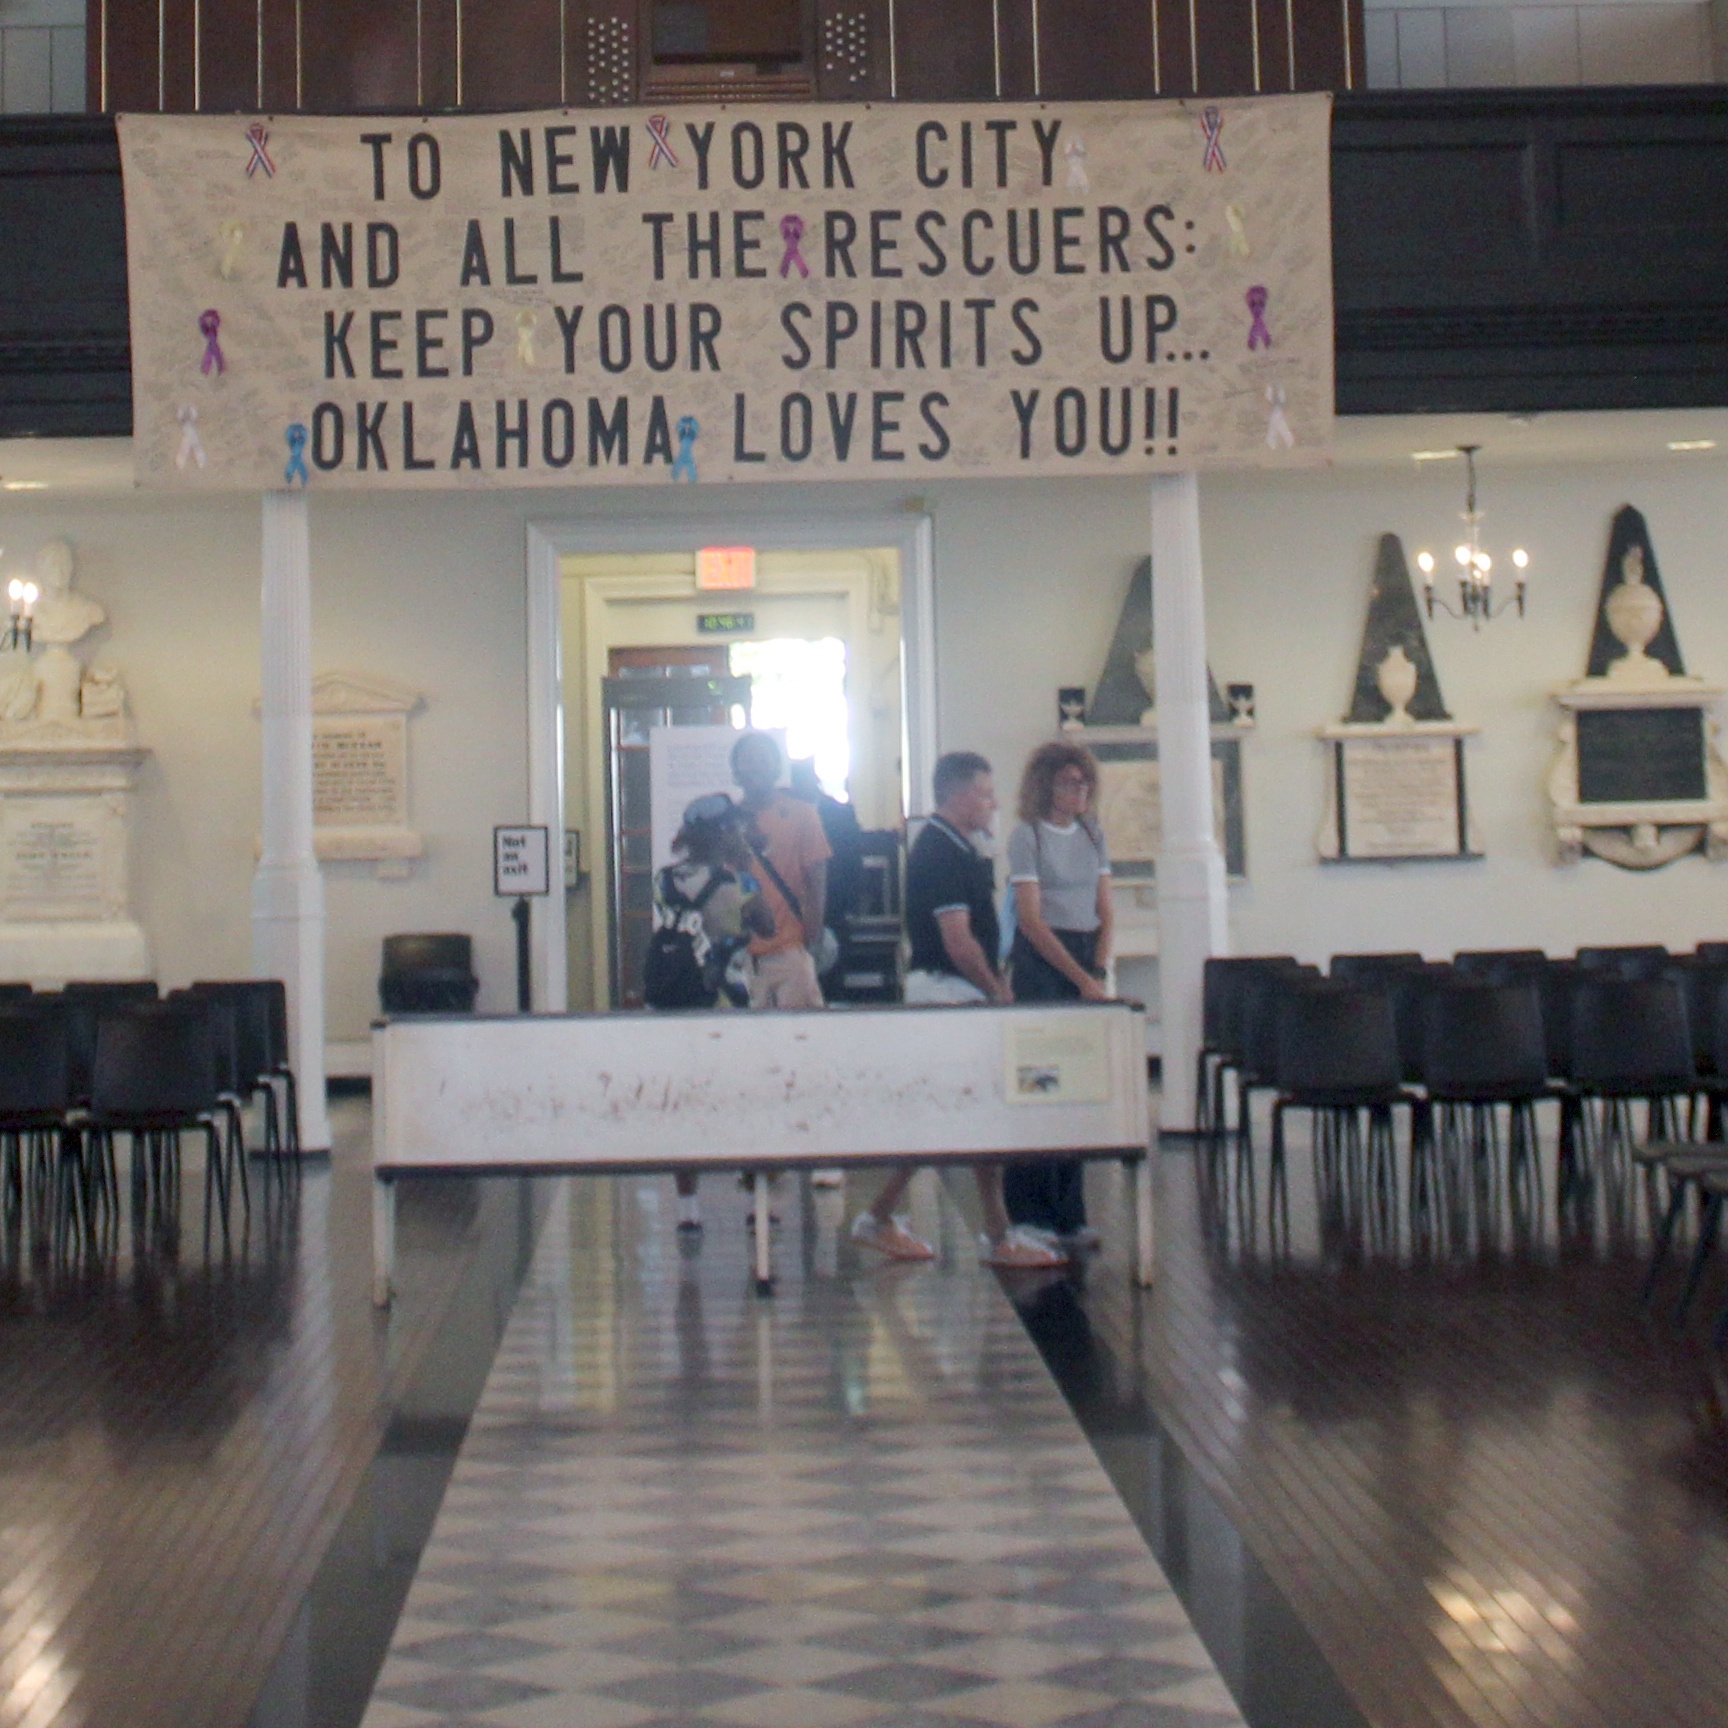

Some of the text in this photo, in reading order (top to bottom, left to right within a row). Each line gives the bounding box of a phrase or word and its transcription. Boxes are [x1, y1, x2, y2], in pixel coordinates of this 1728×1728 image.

[360, 119, 1062, 201] TO NEW YORK CITY
[276, 204, 1196, 289] AND ALL THE RESCUERS:
[323, 294, 1210, 380] KEEP YOUR SPIRITS UP...
[311, 386, 1180, 471] OKLAHOMA LOVES YOU!!
